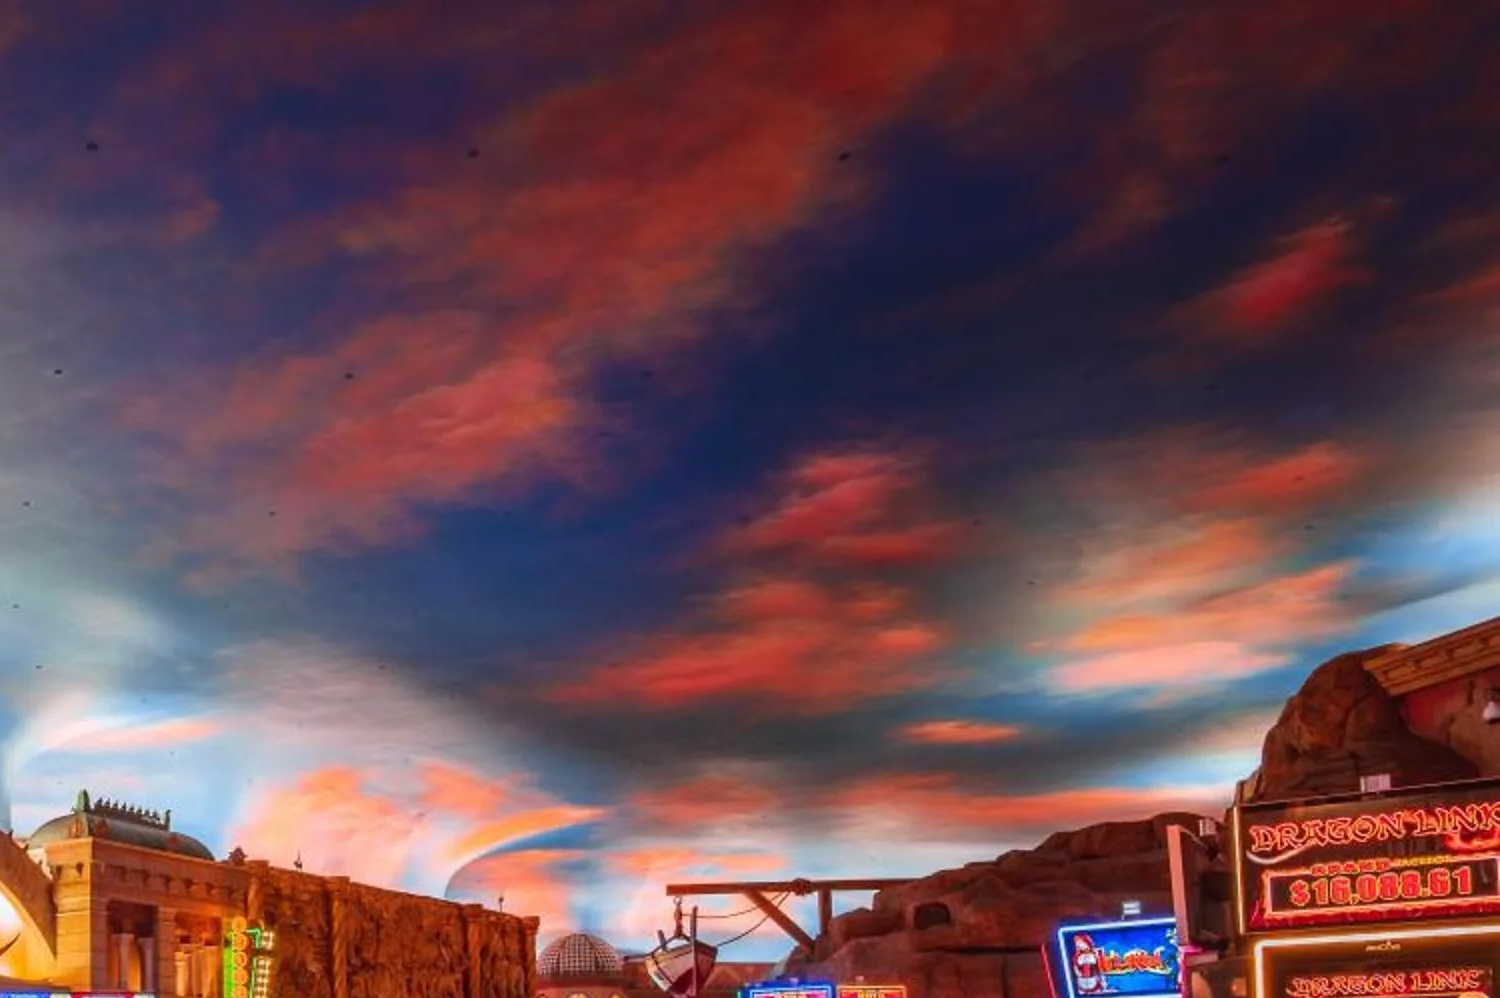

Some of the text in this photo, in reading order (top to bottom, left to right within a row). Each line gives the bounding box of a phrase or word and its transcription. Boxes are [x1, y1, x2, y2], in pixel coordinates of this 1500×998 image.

[1250, 812, 1404, 853] DRAGON
[1290, 865, 1472, 906] $16,088.61
[1293, 969, 1481, 998] DRAGON LINK
